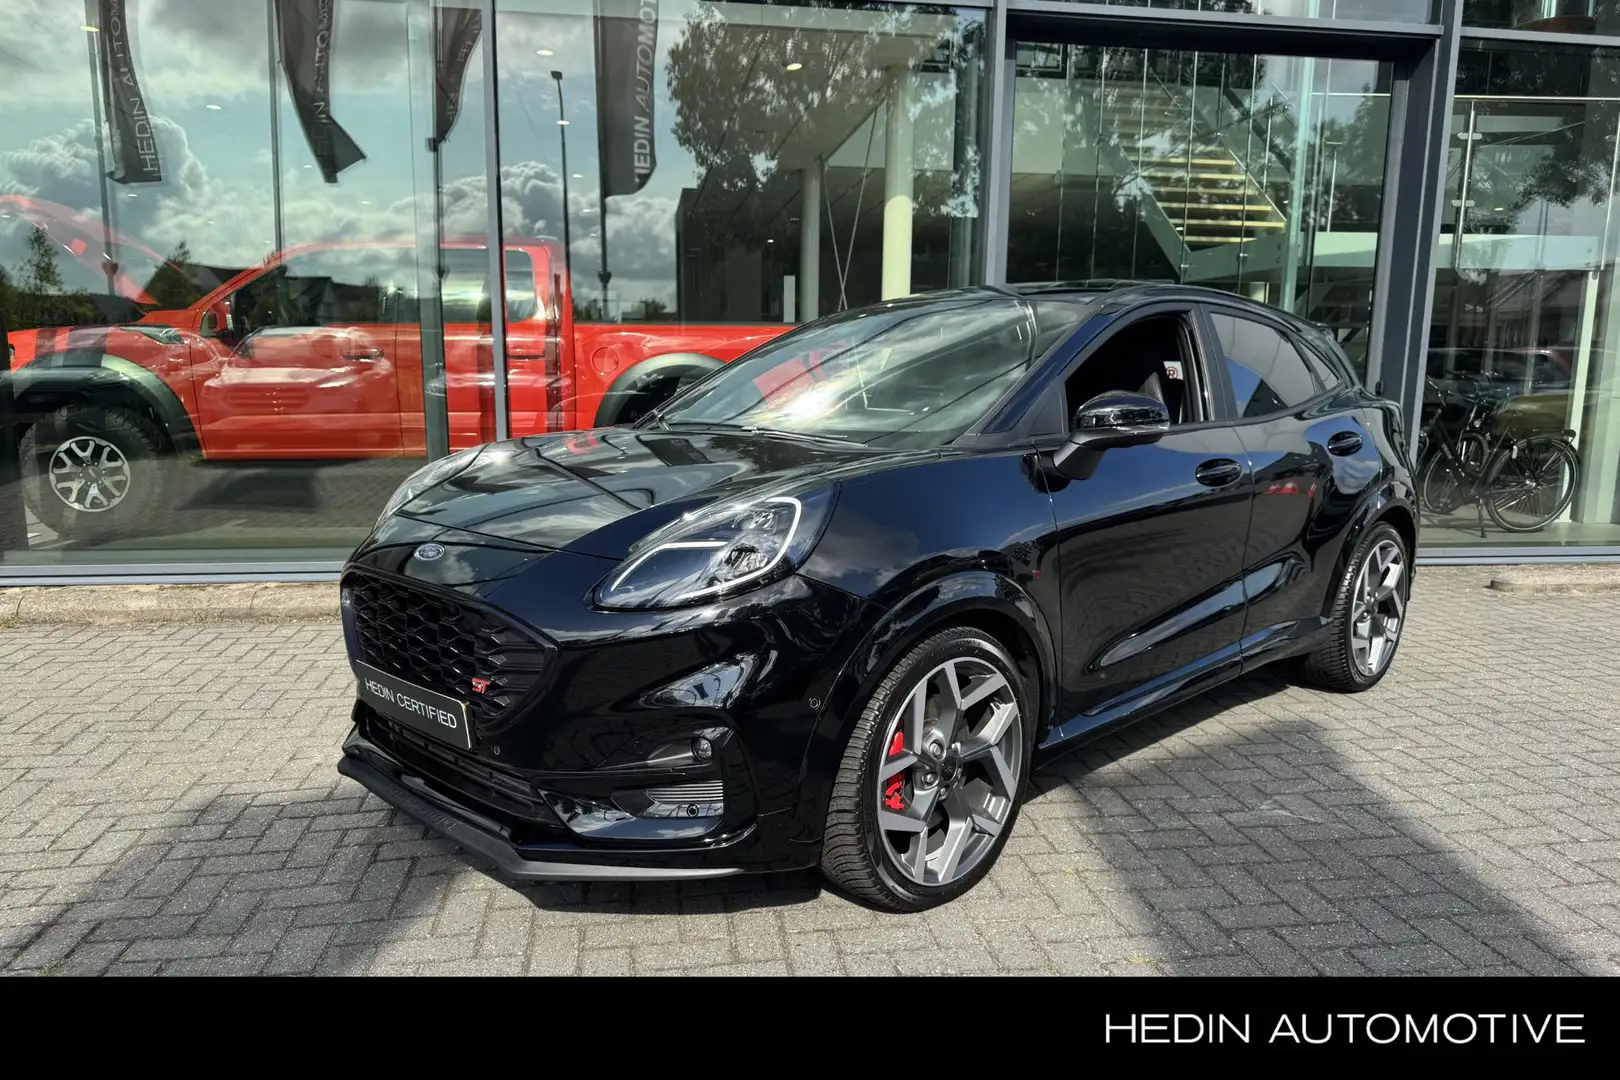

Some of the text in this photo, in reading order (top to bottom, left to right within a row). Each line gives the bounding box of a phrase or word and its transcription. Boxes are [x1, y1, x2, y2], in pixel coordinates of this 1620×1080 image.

[129, 97, 158, 171] HEDIN
[365, 678, 457, 729] HEDIN CERTIFIED
[471, 677, 491, 694] ST
